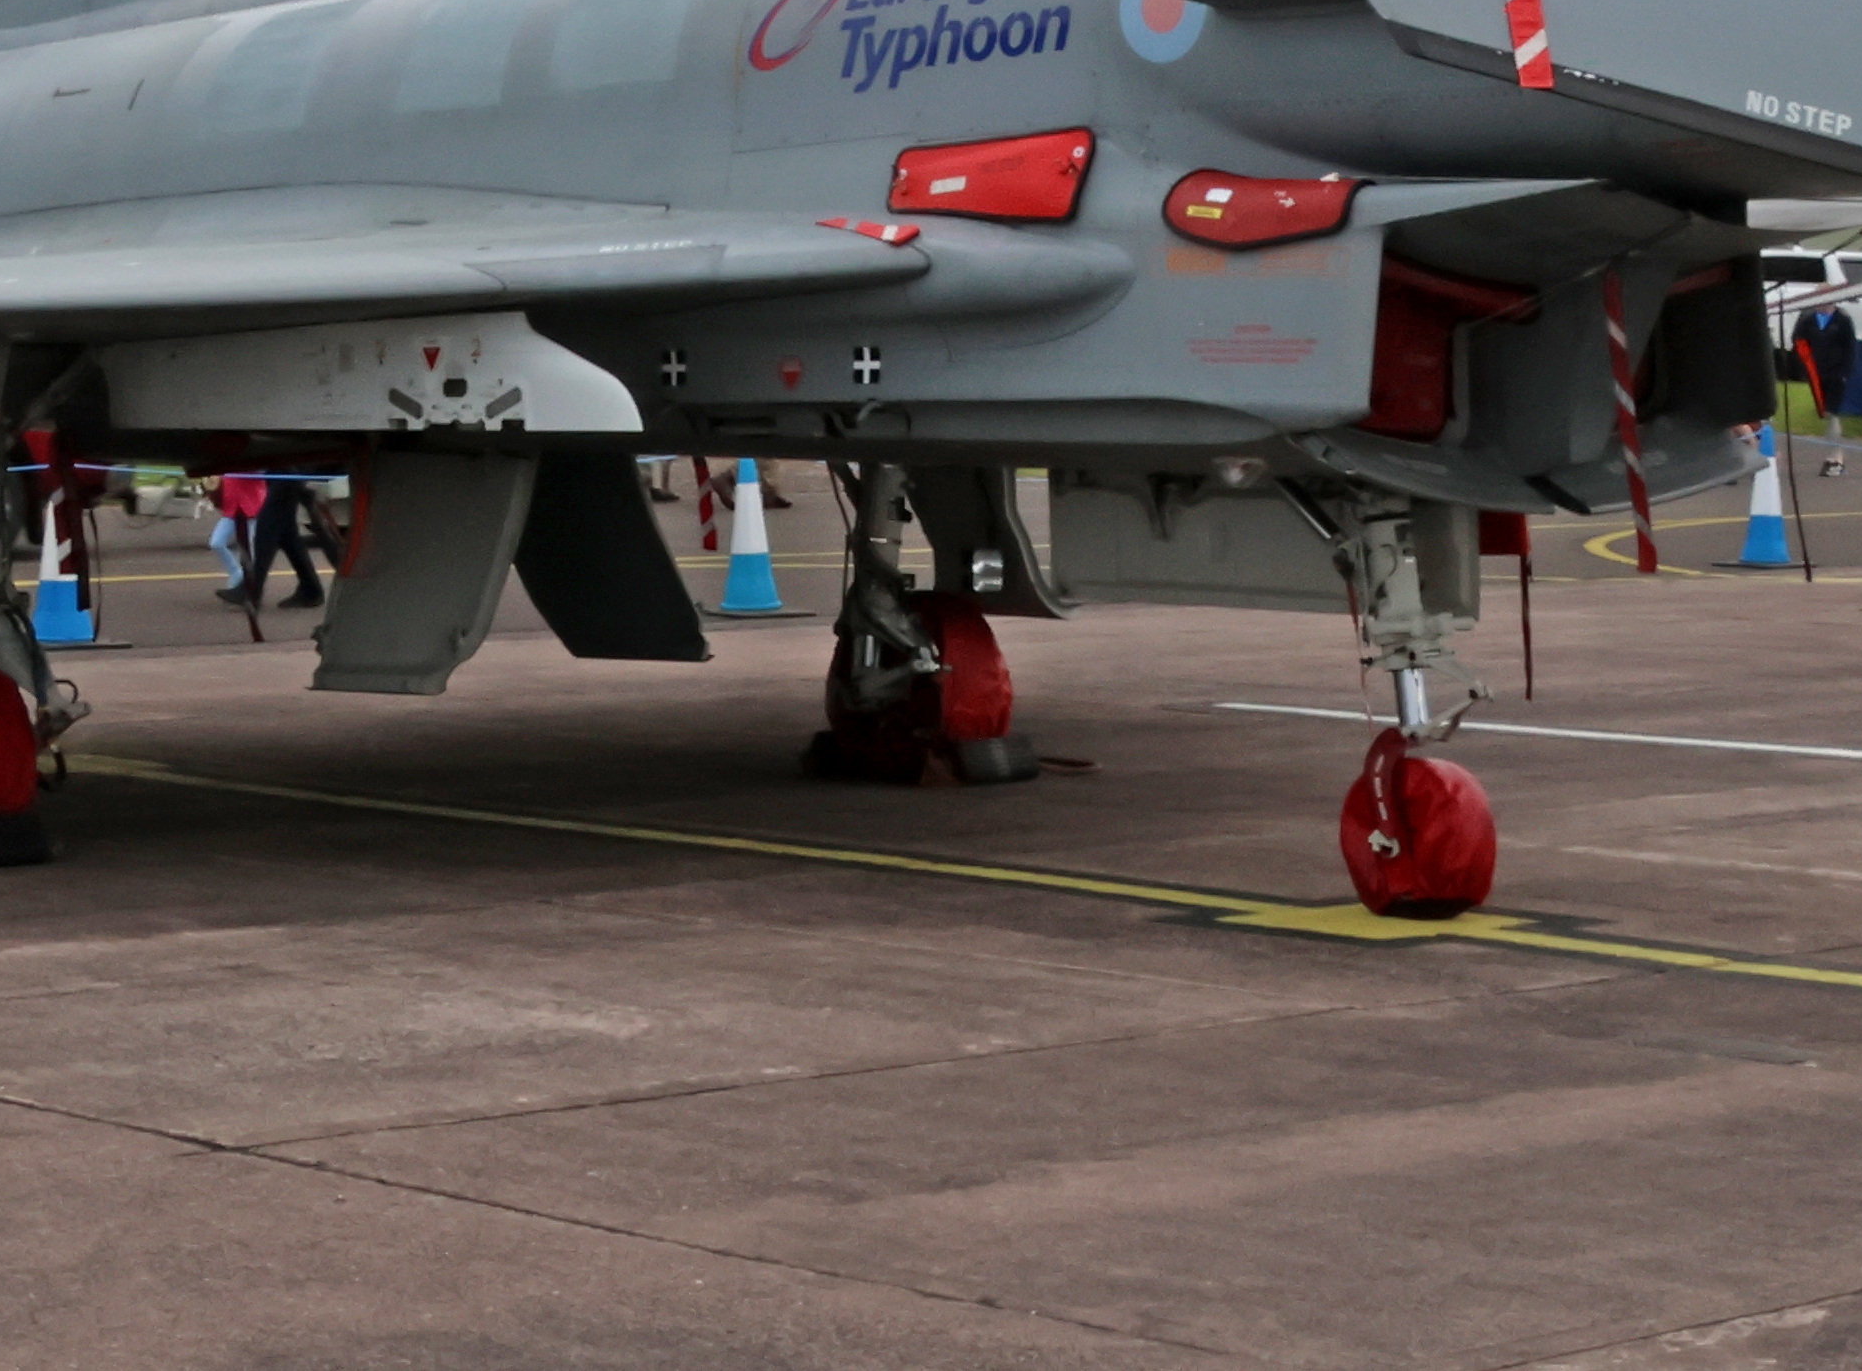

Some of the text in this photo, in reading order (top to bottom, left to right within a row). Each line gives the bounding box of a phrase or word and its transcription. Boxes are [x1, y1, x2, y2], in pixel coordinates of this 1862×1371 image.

[840, 4, 1071, 94] Typhoon
[1746, 90, 1853, 137] NO STEP
